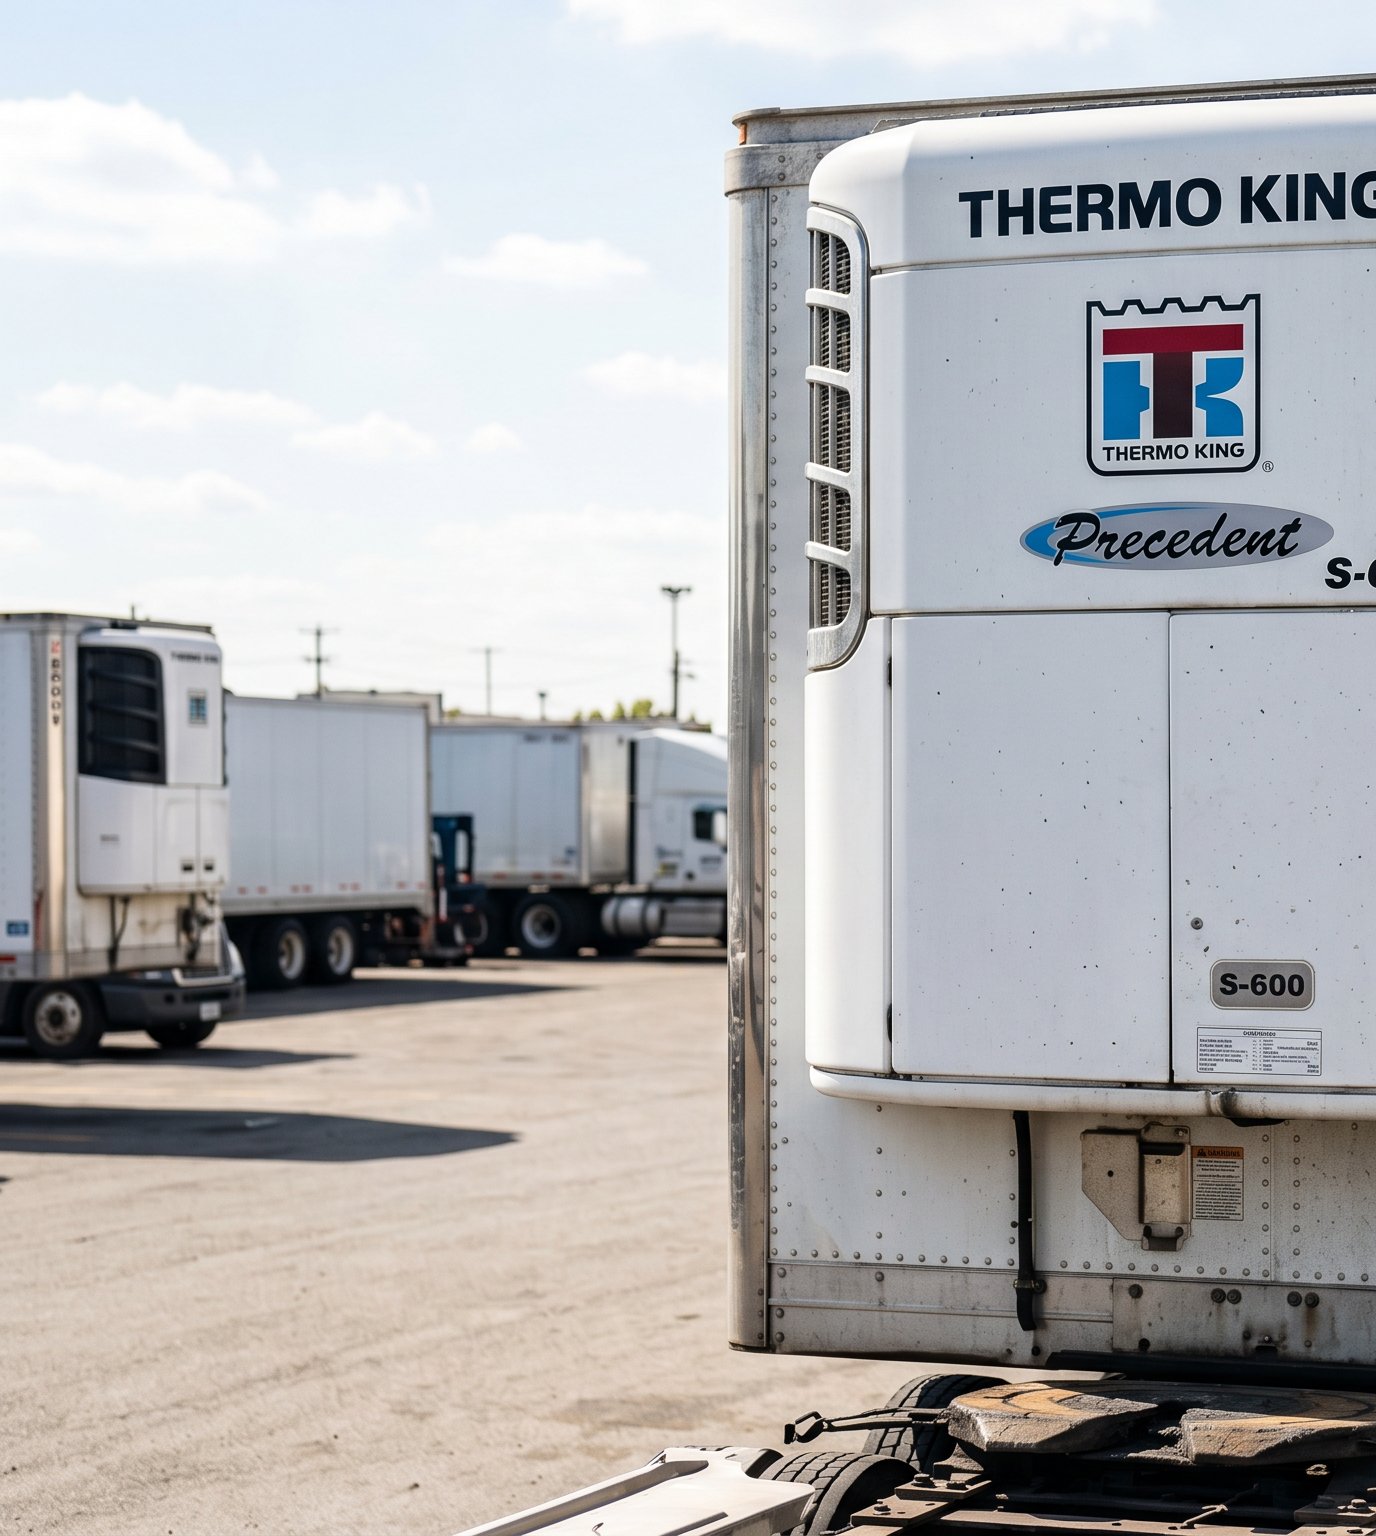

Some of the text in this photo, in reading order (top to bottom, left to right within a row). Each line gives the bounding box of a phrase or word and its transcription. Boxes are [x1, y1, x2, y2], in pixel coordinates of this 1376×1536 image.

[958, 177, 1222, 239] THERMO
[1102, 442, 1245, 462] THERMO KING
[1053, 512, 1303, 567] Precedent
[1219, 972, 1305, 997] S-600
